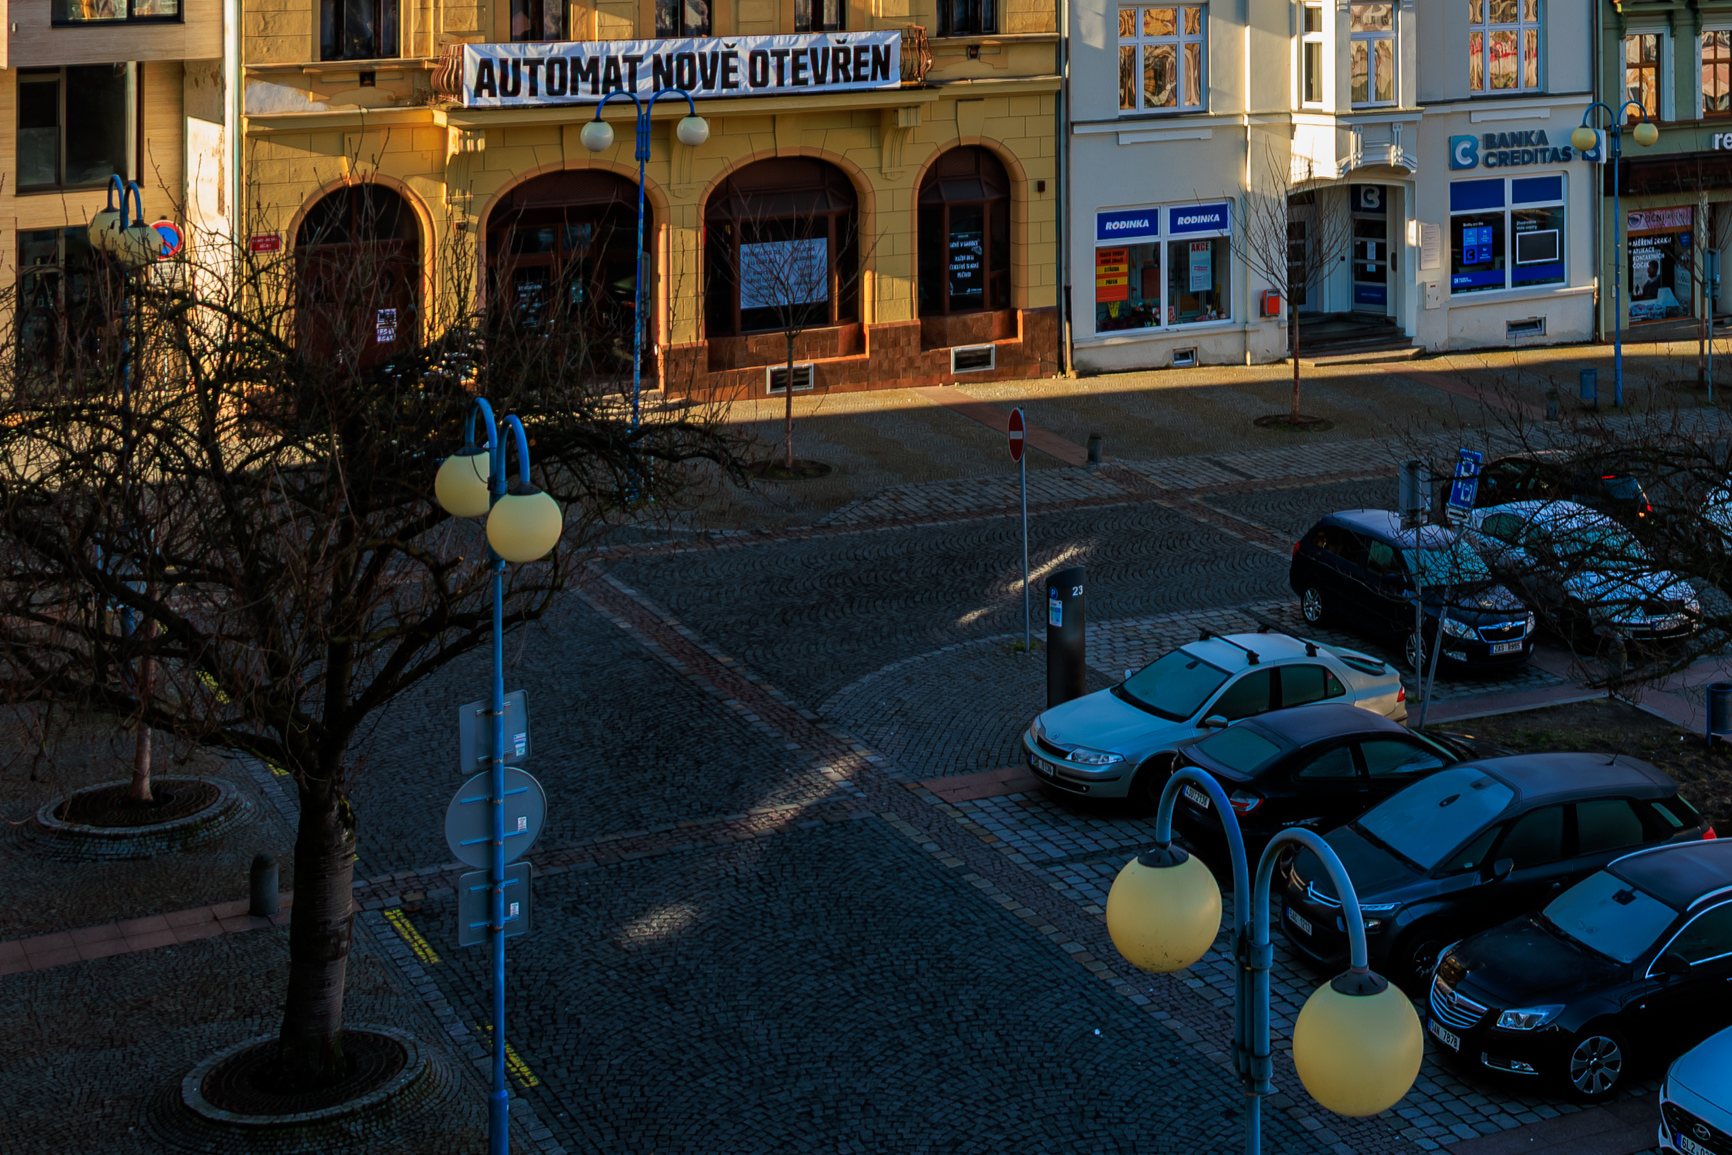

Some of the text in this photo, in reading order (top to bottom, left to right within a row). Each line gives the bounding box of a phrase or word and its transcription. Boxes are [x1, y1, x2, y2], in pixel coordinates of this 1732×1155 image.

[473, 39, 892, 98] AUTOMAT NOVĚ OTEVŘEN
[1483, 130, 1549, 149] BANKA
[1483, 146, 1572, 168] CREDITAS
[1105, 219, 1150, 231] RODINKA
[1177, 214, 1220, 225] RODINKA
[1191, 242, 1209, 253] AKCE
[1072, 585, 1083, 596] 23
